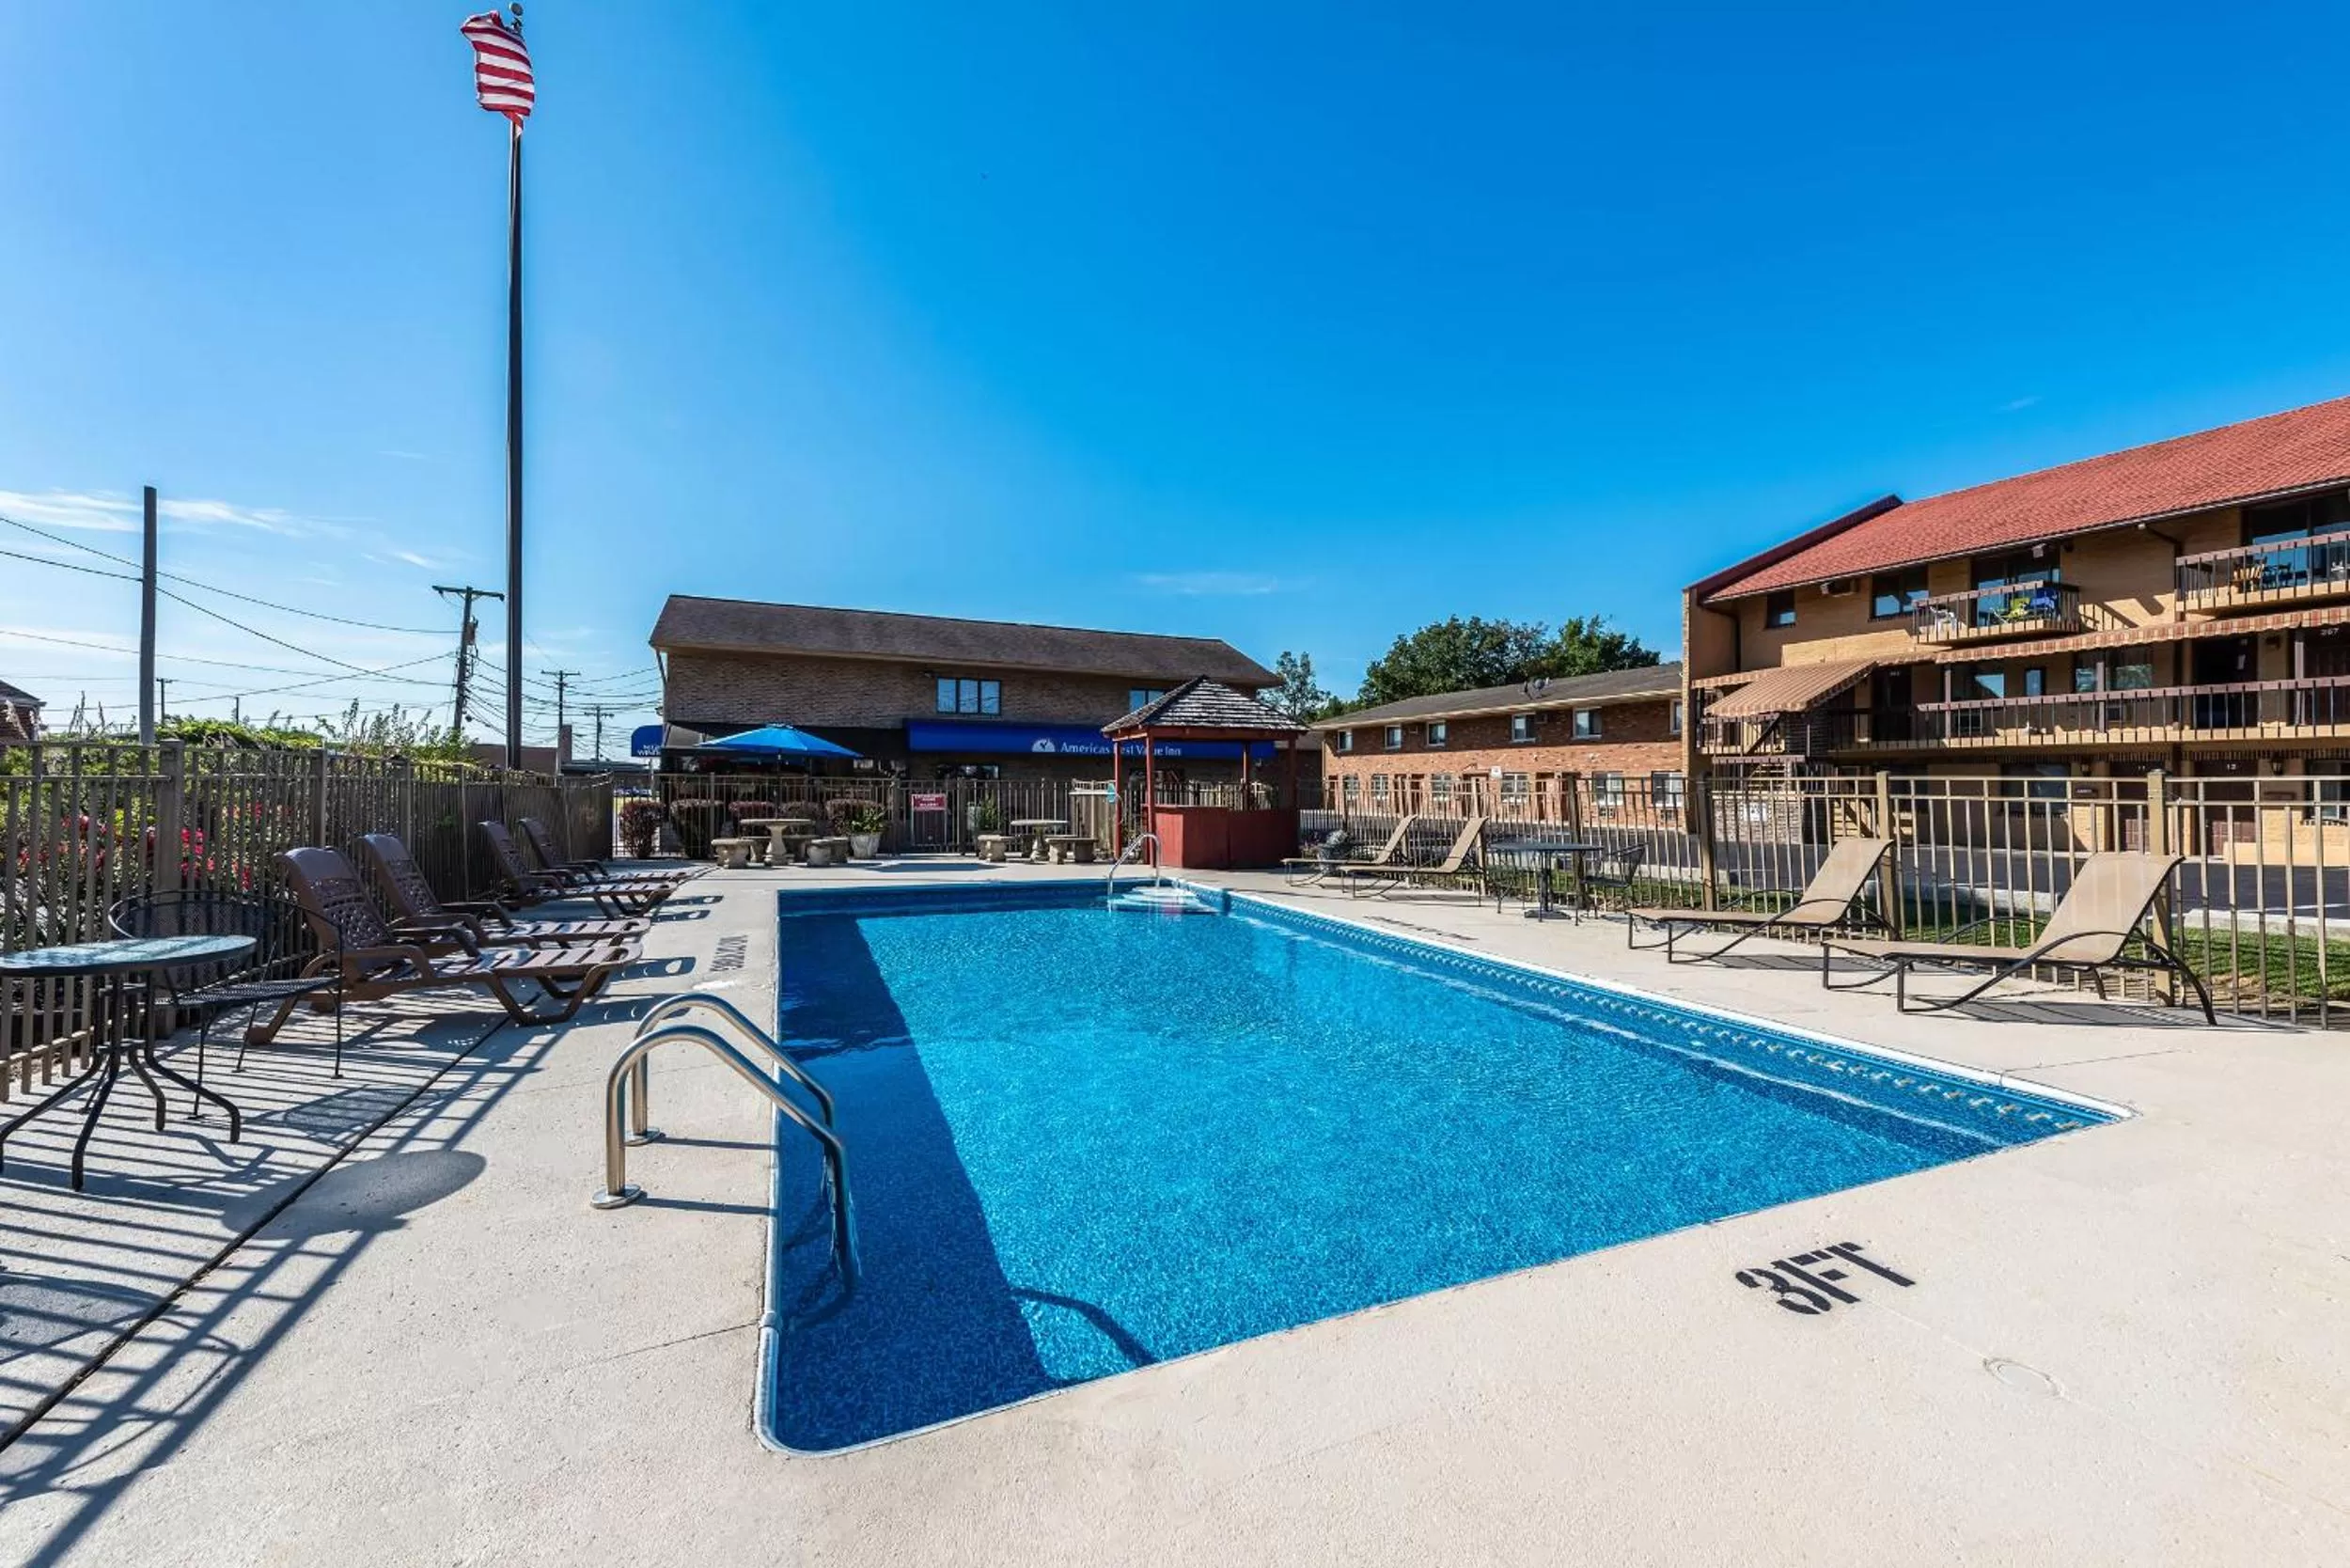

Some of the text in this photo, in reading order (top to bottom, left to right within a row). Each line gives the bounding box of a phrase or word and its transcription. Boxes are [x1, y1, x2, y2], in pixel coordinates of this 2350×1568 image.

[1059, 742, 1110, 755] Americas
[1113, 743, 1134, 755] est
[1165, 745, 1182, 757] Inn
[1735, 1241, 1916, 1315] 3FT
